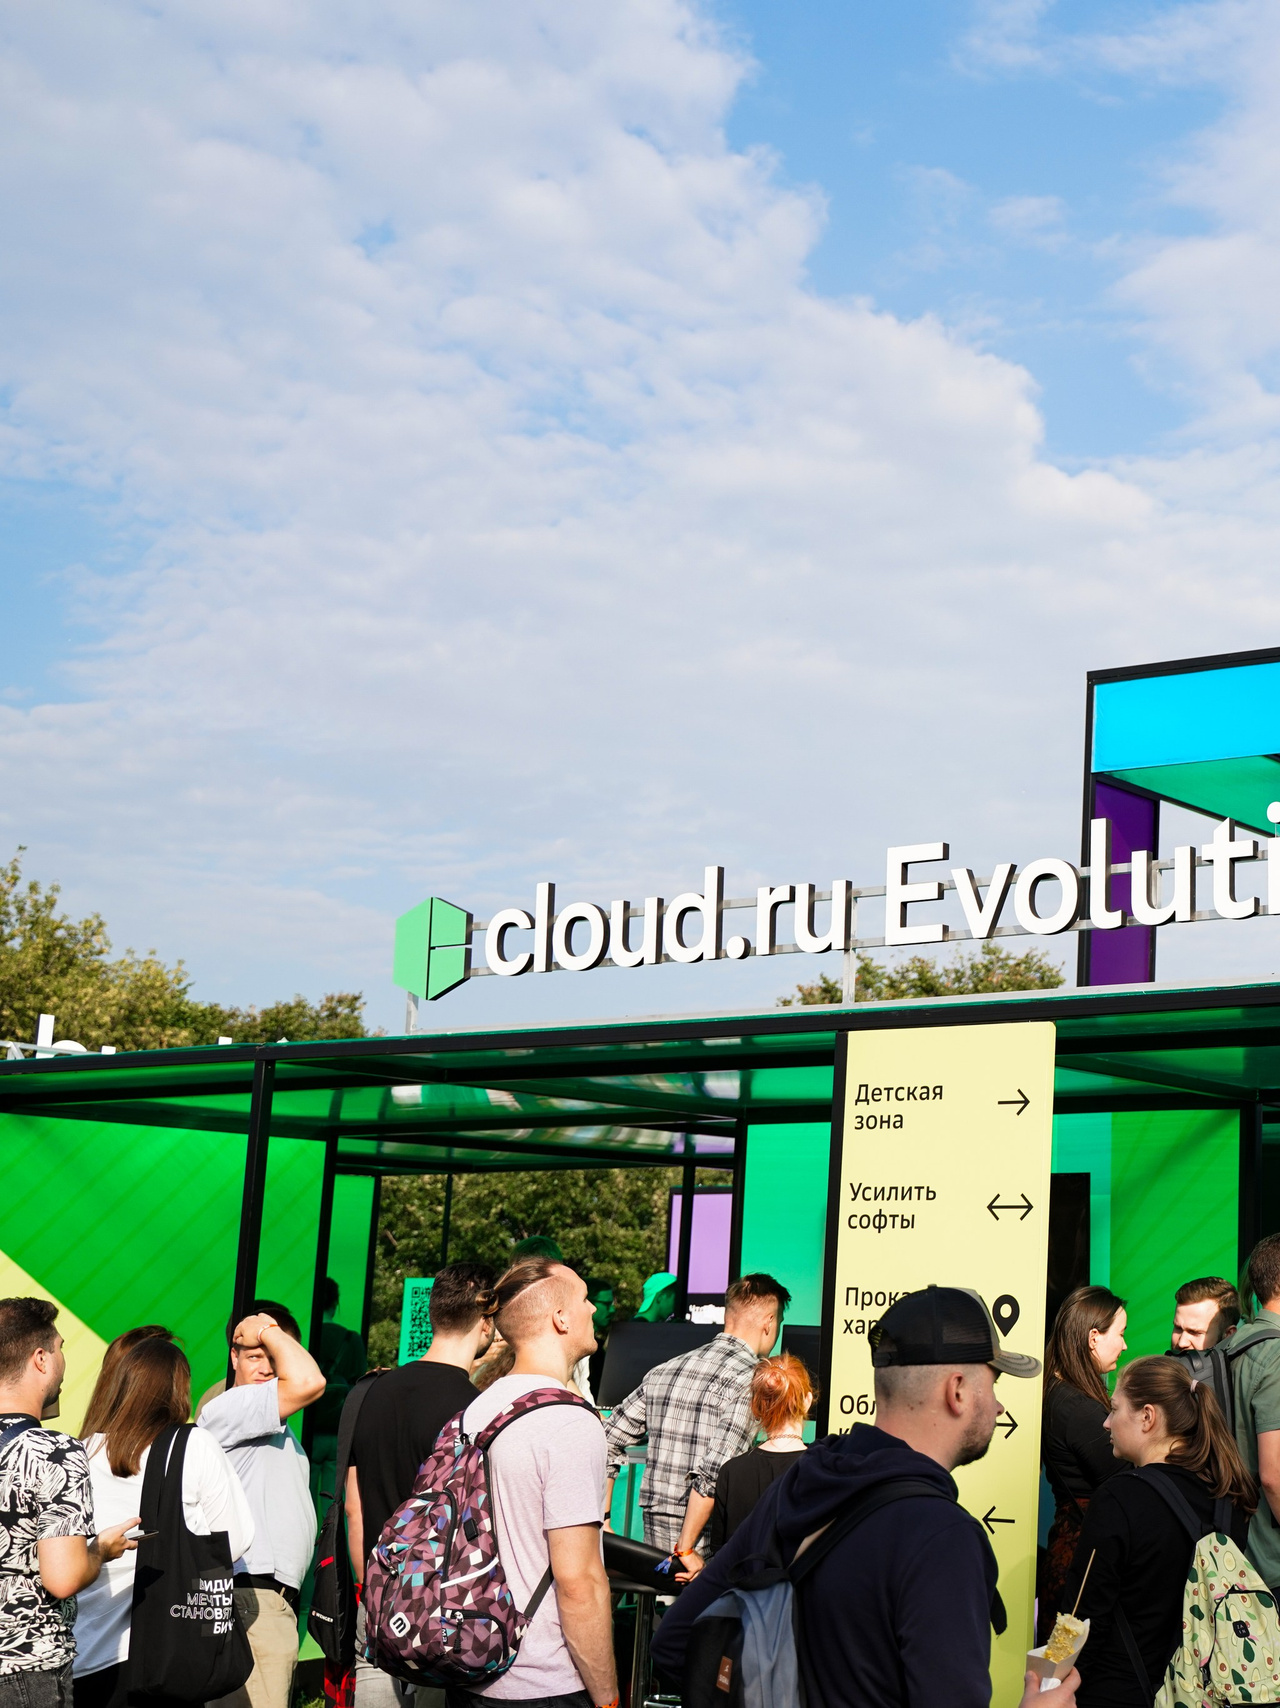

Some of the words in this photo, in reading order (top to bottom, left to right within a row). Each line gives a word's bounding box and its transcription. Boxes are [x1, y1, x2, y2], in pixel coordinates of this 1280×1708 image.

[485, 866, 852, 976] cloud.ru
[855, 1084, 943, 1105] Детская
[854, 1113, 904, 1130] зона
[849, 1183, 937, 1201] Усилить
[847, 1208, 915, 1233] софты
[845, 1286, 912, 1311] Прок
[187, 1593, 233, 1607] МЕЧТЫ
